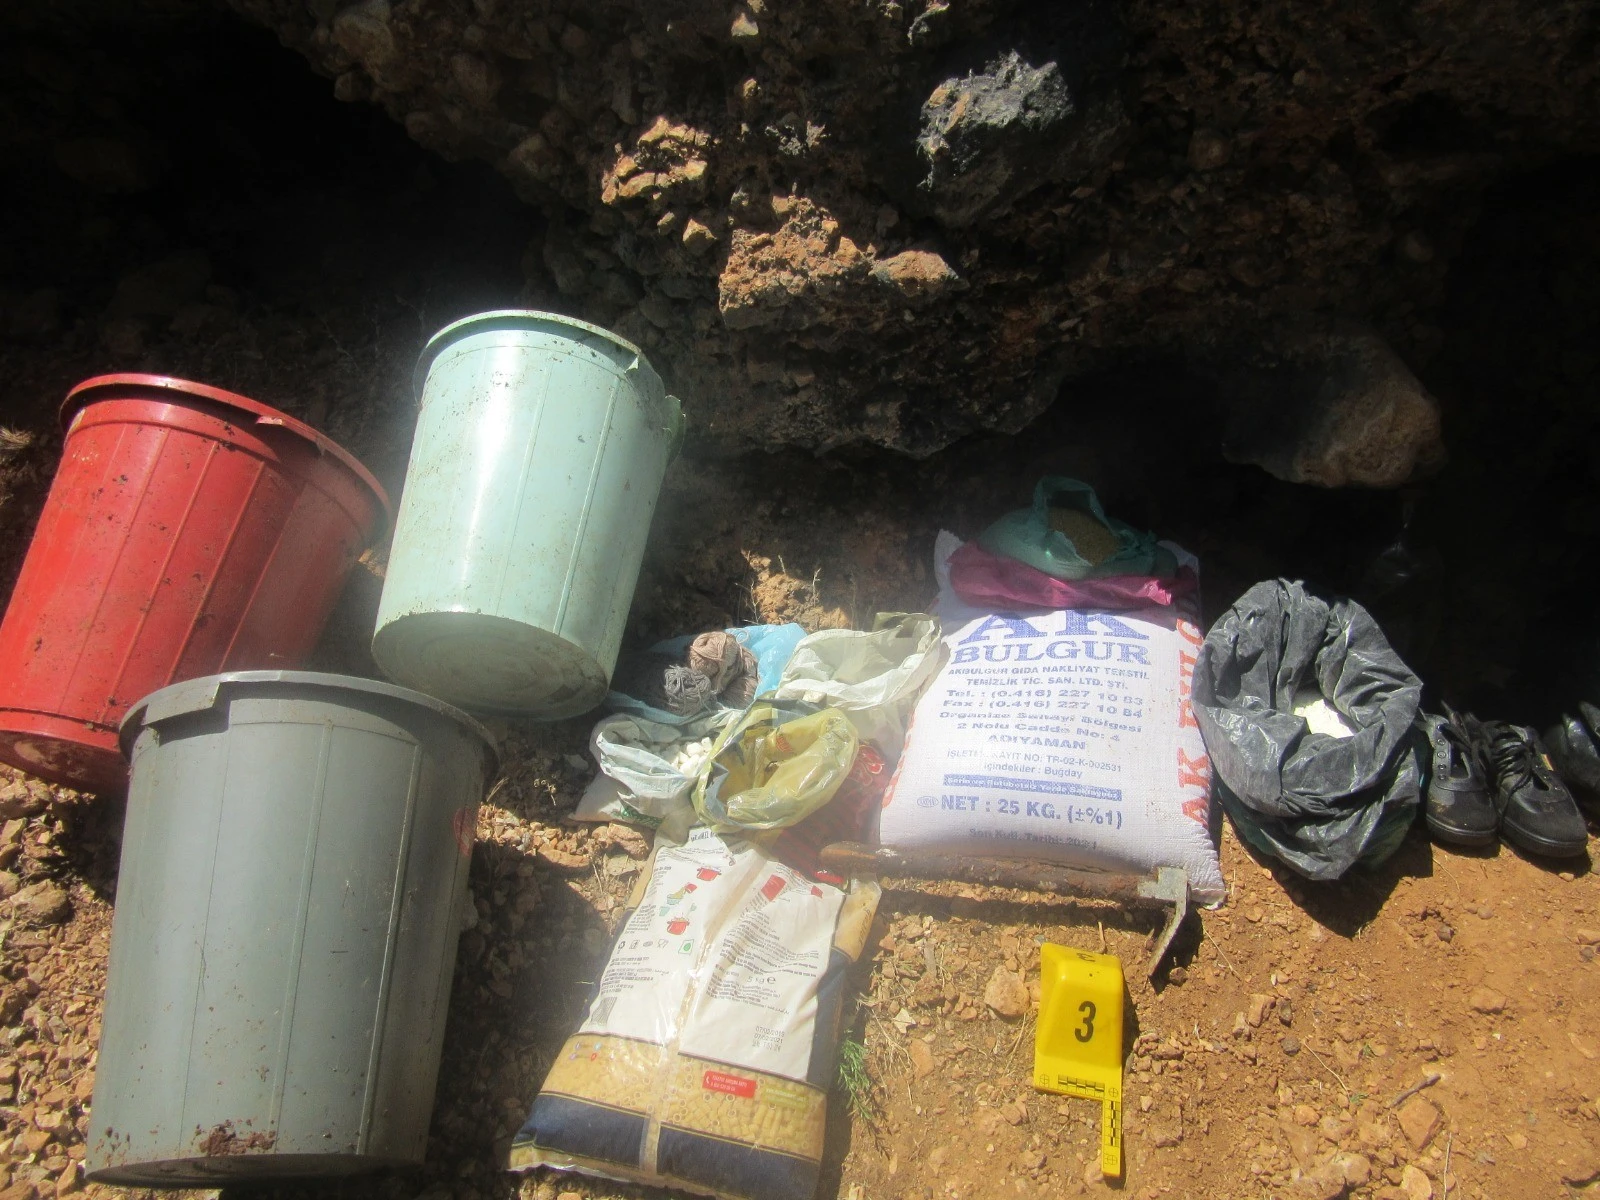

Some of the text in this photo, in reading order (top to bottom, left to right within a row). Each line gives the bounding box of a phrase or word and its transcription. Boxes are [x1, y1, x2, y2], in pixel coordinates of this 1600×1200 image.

[958, 609, 1149, 645] AK
[951, 640, 1152, 665] BULGUR
[948, 667, 1008, 675] AKBULGUR
[1042, 665, 1100, 673] NAKLİYAT
[1047, 676, 1075, 684] SAN.
[1079, 677, 1103, 686] LTD.
[946, 689, 975, 697] Tel.
[991, 689, 1052, 698] (0.416)
[1058, 689, 1090, 697] 227
[1098, 692, 1118, 702] 10
[943, 699, 973, 707] Fax
[989, 700, 1050, 709] (0.416)
[1057, 700, 1090, 709] 227
[1096, 704, 1118, 714] 10
[957, 722, 967, 730] 2
[971, 722, 1009, 730] Nolu
[1015, 723, 1071, 733] Cadde
[988, 734, 1086, 750] ADIYAMAN
[1024, 753, 1042, 763] NO:
[1046, 755, 1121, 772] TR-02-K-002531
[1044, 766, 1083, 779] Buğday
[1176, 747, 1211, 829] AK
[941, 794, 979, 811] NET
[997, 798, 1020, 815] 25
[1026, 801, 1061, 819] KG.
[1067, 804, 1122, 830] (±%1)
[1074, 1000, 1097, 1042] 3
